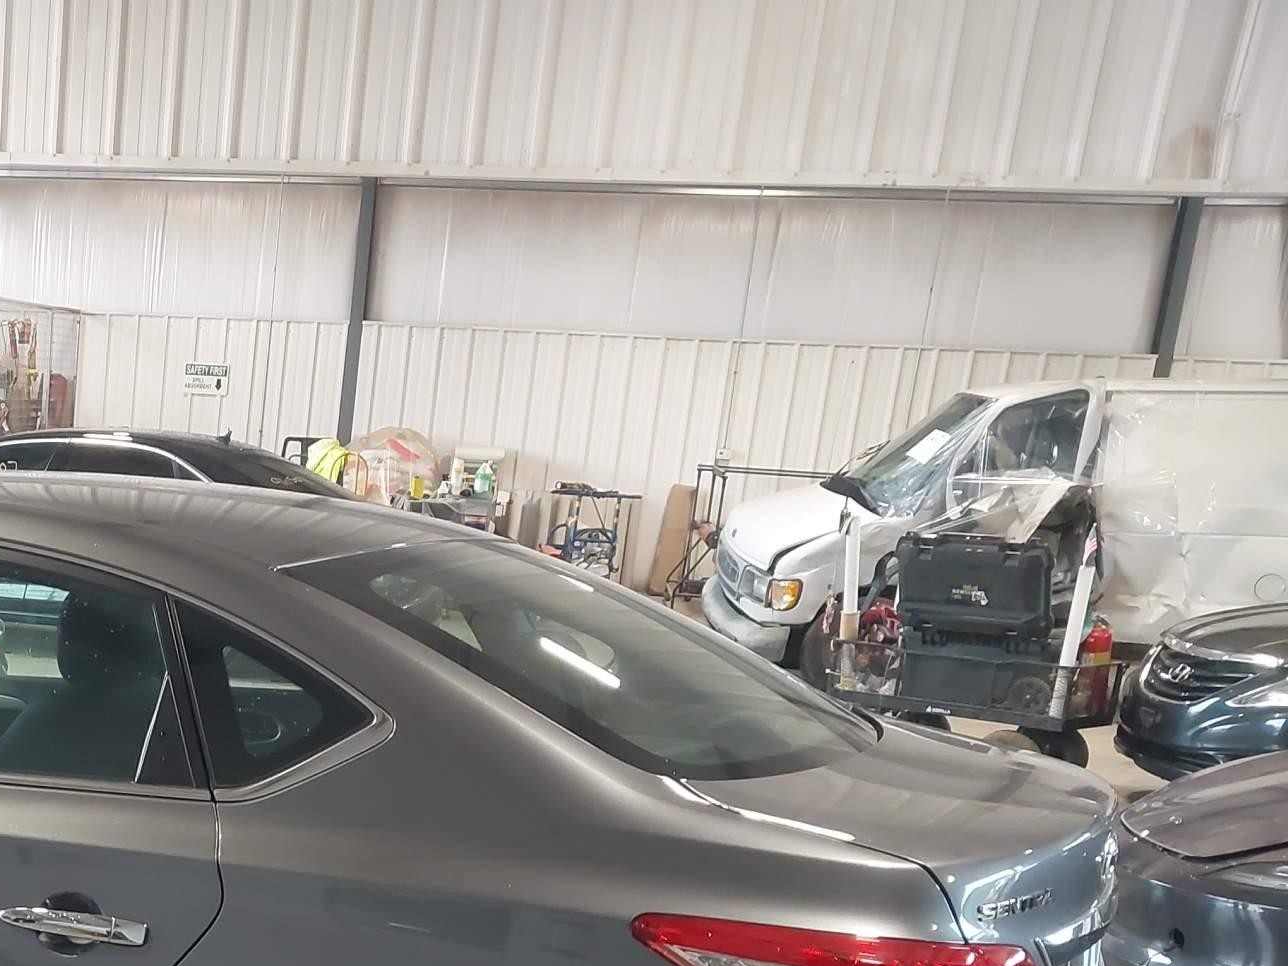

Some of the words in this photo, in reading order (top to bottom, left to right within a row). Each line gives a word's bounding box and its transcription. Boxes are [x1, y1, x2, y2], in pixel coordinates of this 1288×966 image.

[186, 365, 209, 376] SAFETY
[209, 366, 227, 377] FIRST
[977, 887, 1054, 921] SENTRA
